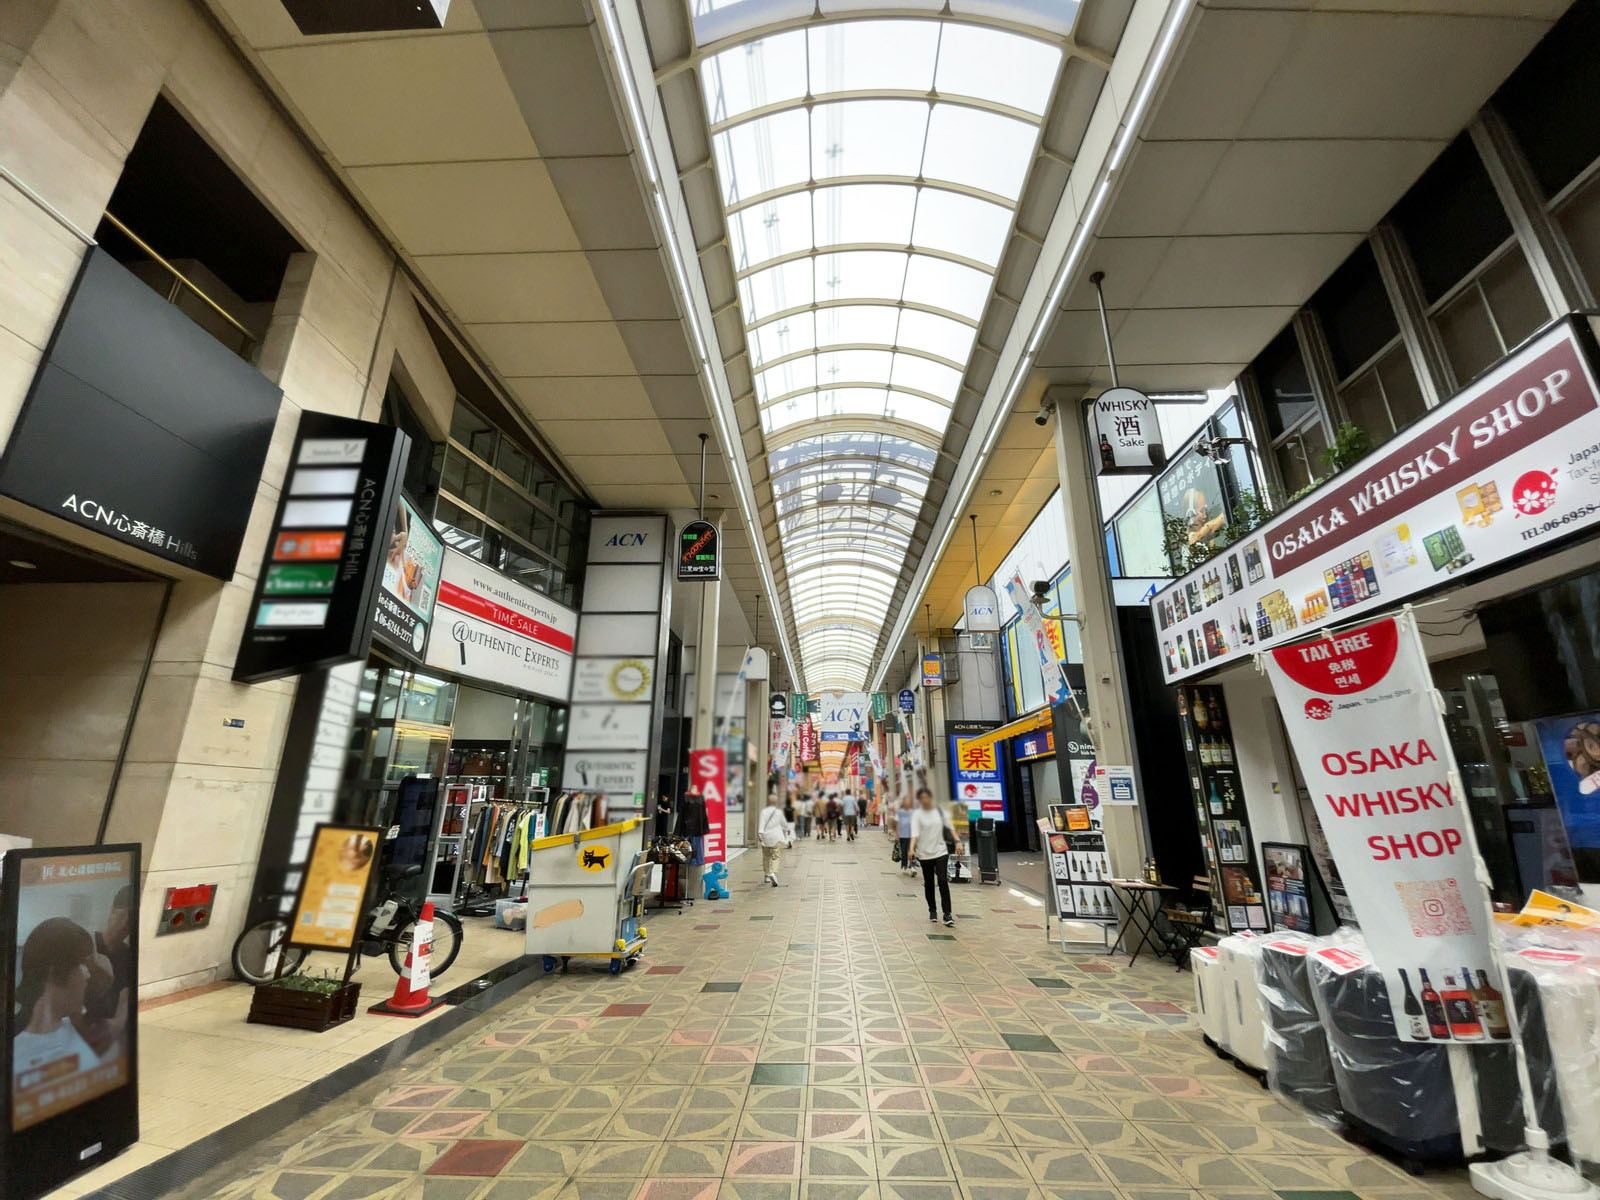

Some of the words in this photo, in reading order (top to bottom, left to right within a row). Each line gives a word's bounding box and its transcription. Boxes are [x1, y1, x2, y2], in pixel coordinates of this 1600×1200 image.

[1098, 400, 1149, 412] WHISKY
[1113, 414, 1142, 436] 酒
[1119, 437, 1144, 447] Sake
[1271, 507, 1349, 561] OSAKA
[1348, 426, 1461, 517] WHISKY
[1469, 368, 1571, 450] SHOP
[61, 494, 166, 547] ACN心斎橋
[166, 535, 198, 560] Hills
[1520, 502, 1600, 541] TEL:06-6958-
[604, 533, 649, 547] ACN
[492, 606, 515, 626] TIME
[517, 618, 539, 636] SALE
[970, 606, 995, 616] ACN
[1298, 643, 1332, 663] TAX
[1333, 632, 1373, 656] FREE
[1327, 658, 1357, 675] 免税
[824, 707, 865, 722] ACN
[1321, 739, 1437, 776] OSAKA
[1325, 780, 1455, 818] WHISKY
[1367, 828, 1462, 861] SHOP
